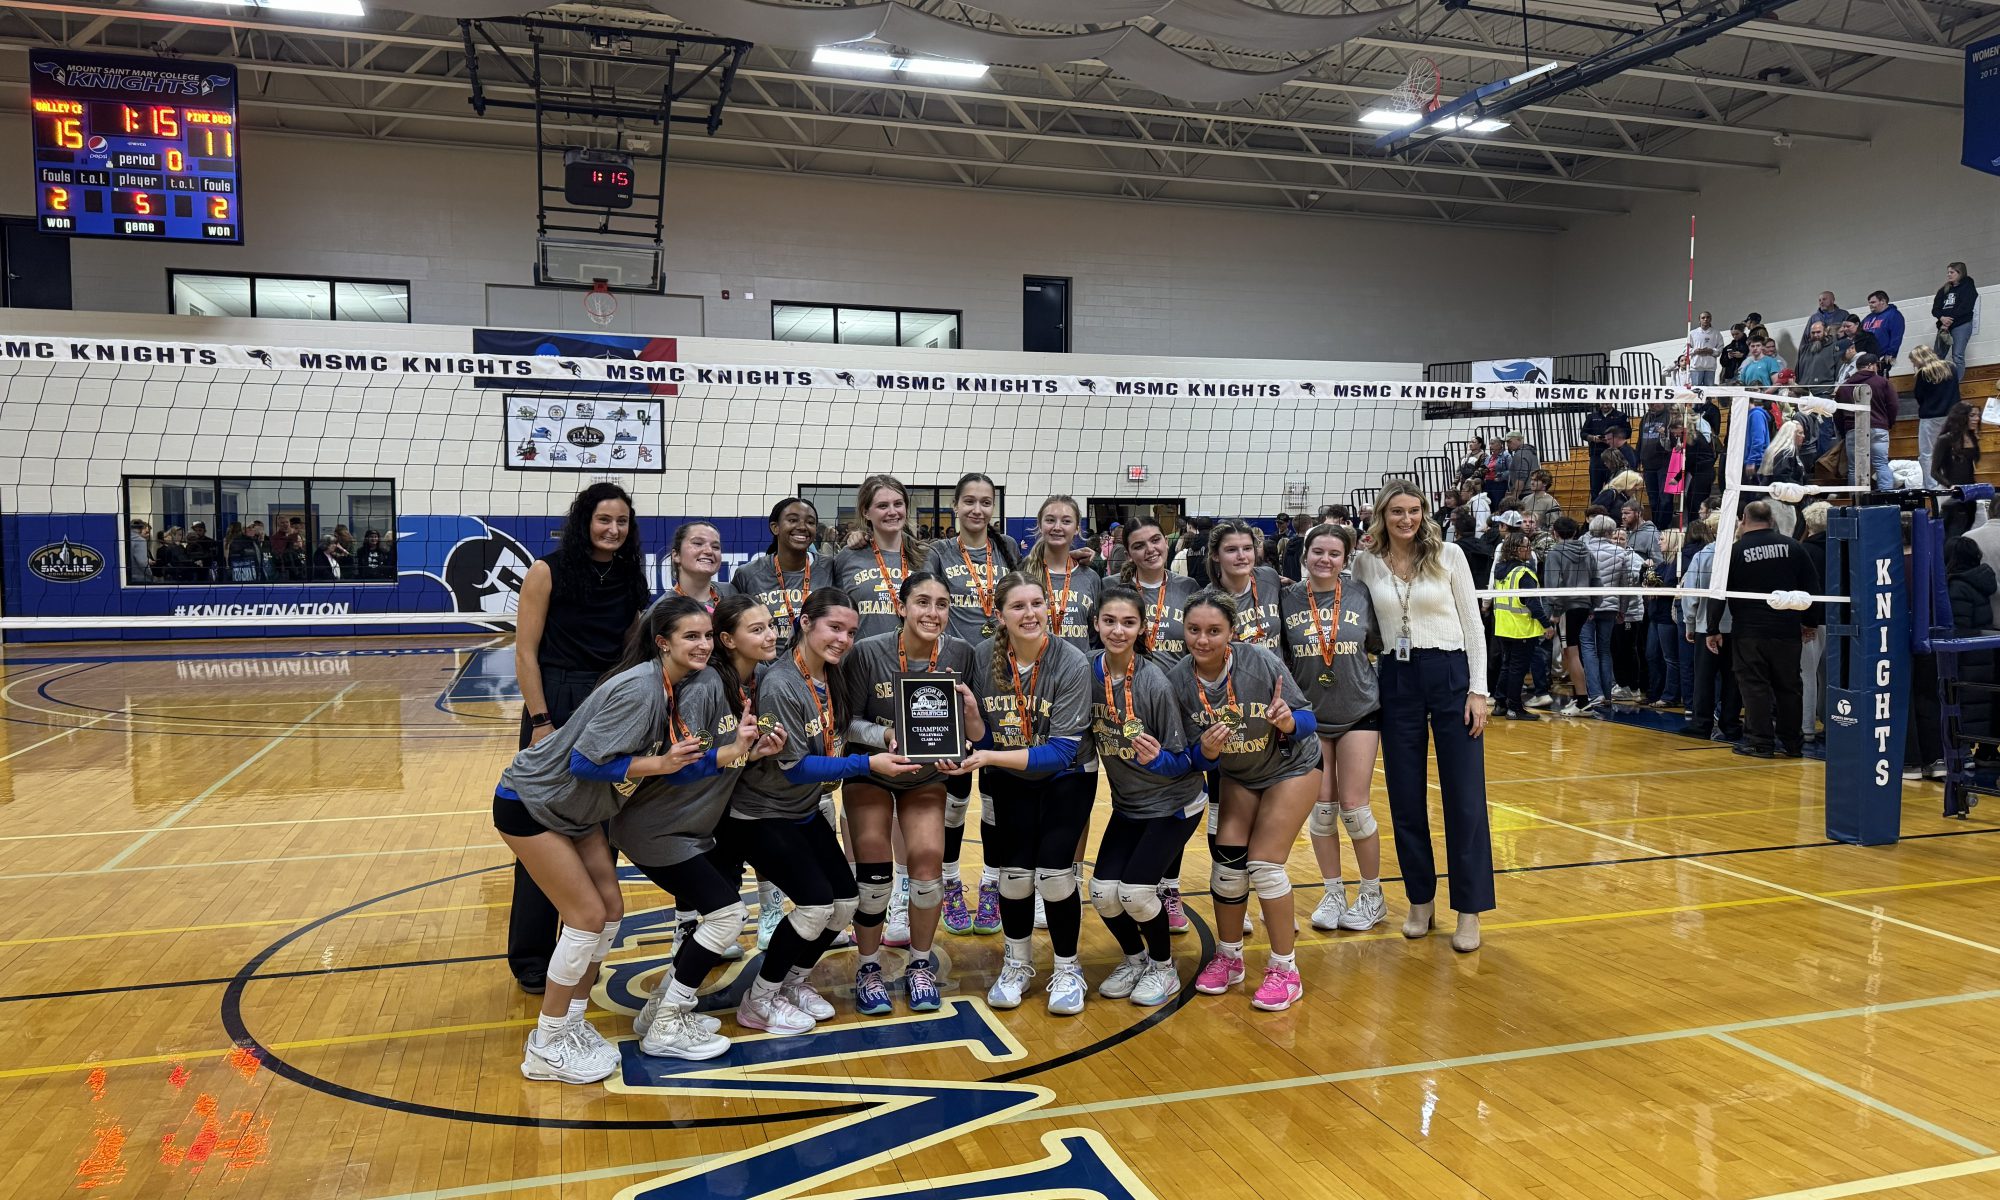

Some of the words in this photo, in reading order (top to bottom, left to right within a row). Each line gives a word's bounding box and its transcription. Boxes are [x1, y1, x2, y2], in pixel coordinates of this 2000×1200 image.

[67, 64, 102, 74] MOUNT
[104, 67, 131, 76] SAINT
[132, 69, 158, 78] MARY
[160, 71, 200, 81] COLLEGE
[67, 72, 201, 95] KNIGHTS
[124, 105, 178, 137] 1:15
[55, 118, 84, 149] 15
[206, 130, 233, 158] 11
[119, 153, 156, 167] period
[168, 149, 183, 172] 0
[42, 168, 71, 183] fouls
[119, 172, 158, 188] player
[592, 170, 629, 186] 1:15
[204, 178, 231, 192] fouls
[53, 186, 68, 211] 2
[136, 193, 150, 215] 5
[214, 198, 228, 219] 2
[46, 217, 71, 229] won
[125, 220, 155, 234] game
[207, 225, 231, 237] won
[71, 343, 217, 365] KNIGHTS
[299, 353, 389, 372] MSMC
[402, 356, 532, 376] KNIGHTS
[606, 364, 686, 383] MSMC
[698, 368, 813, 386] KNIGHTS
[876, 374, 946, 391] MSMC
[956, 377, 1059, 393] KNIGHTS
[1115, 381, 1179, 396] MSMC
[1187, 383, 1281, 397] KNIGHTS
[1333, 384, 1392, 398] MSMC
[1400, 385, 1487, 399] KNIGHTS
[1535, 387, 1589, 400] MSMC
[1595, 387, 1676, 400] KNIGHTS
[1743, 543, 1789, 563] SECURITY
[40, 564, 94, 573] SKYLINE
[174, 602, 350, 617] #KNIGHTNATION
[1344, 610, 1360, 626] IX
[1873, 558, 1893, 787] KNIGHTS
